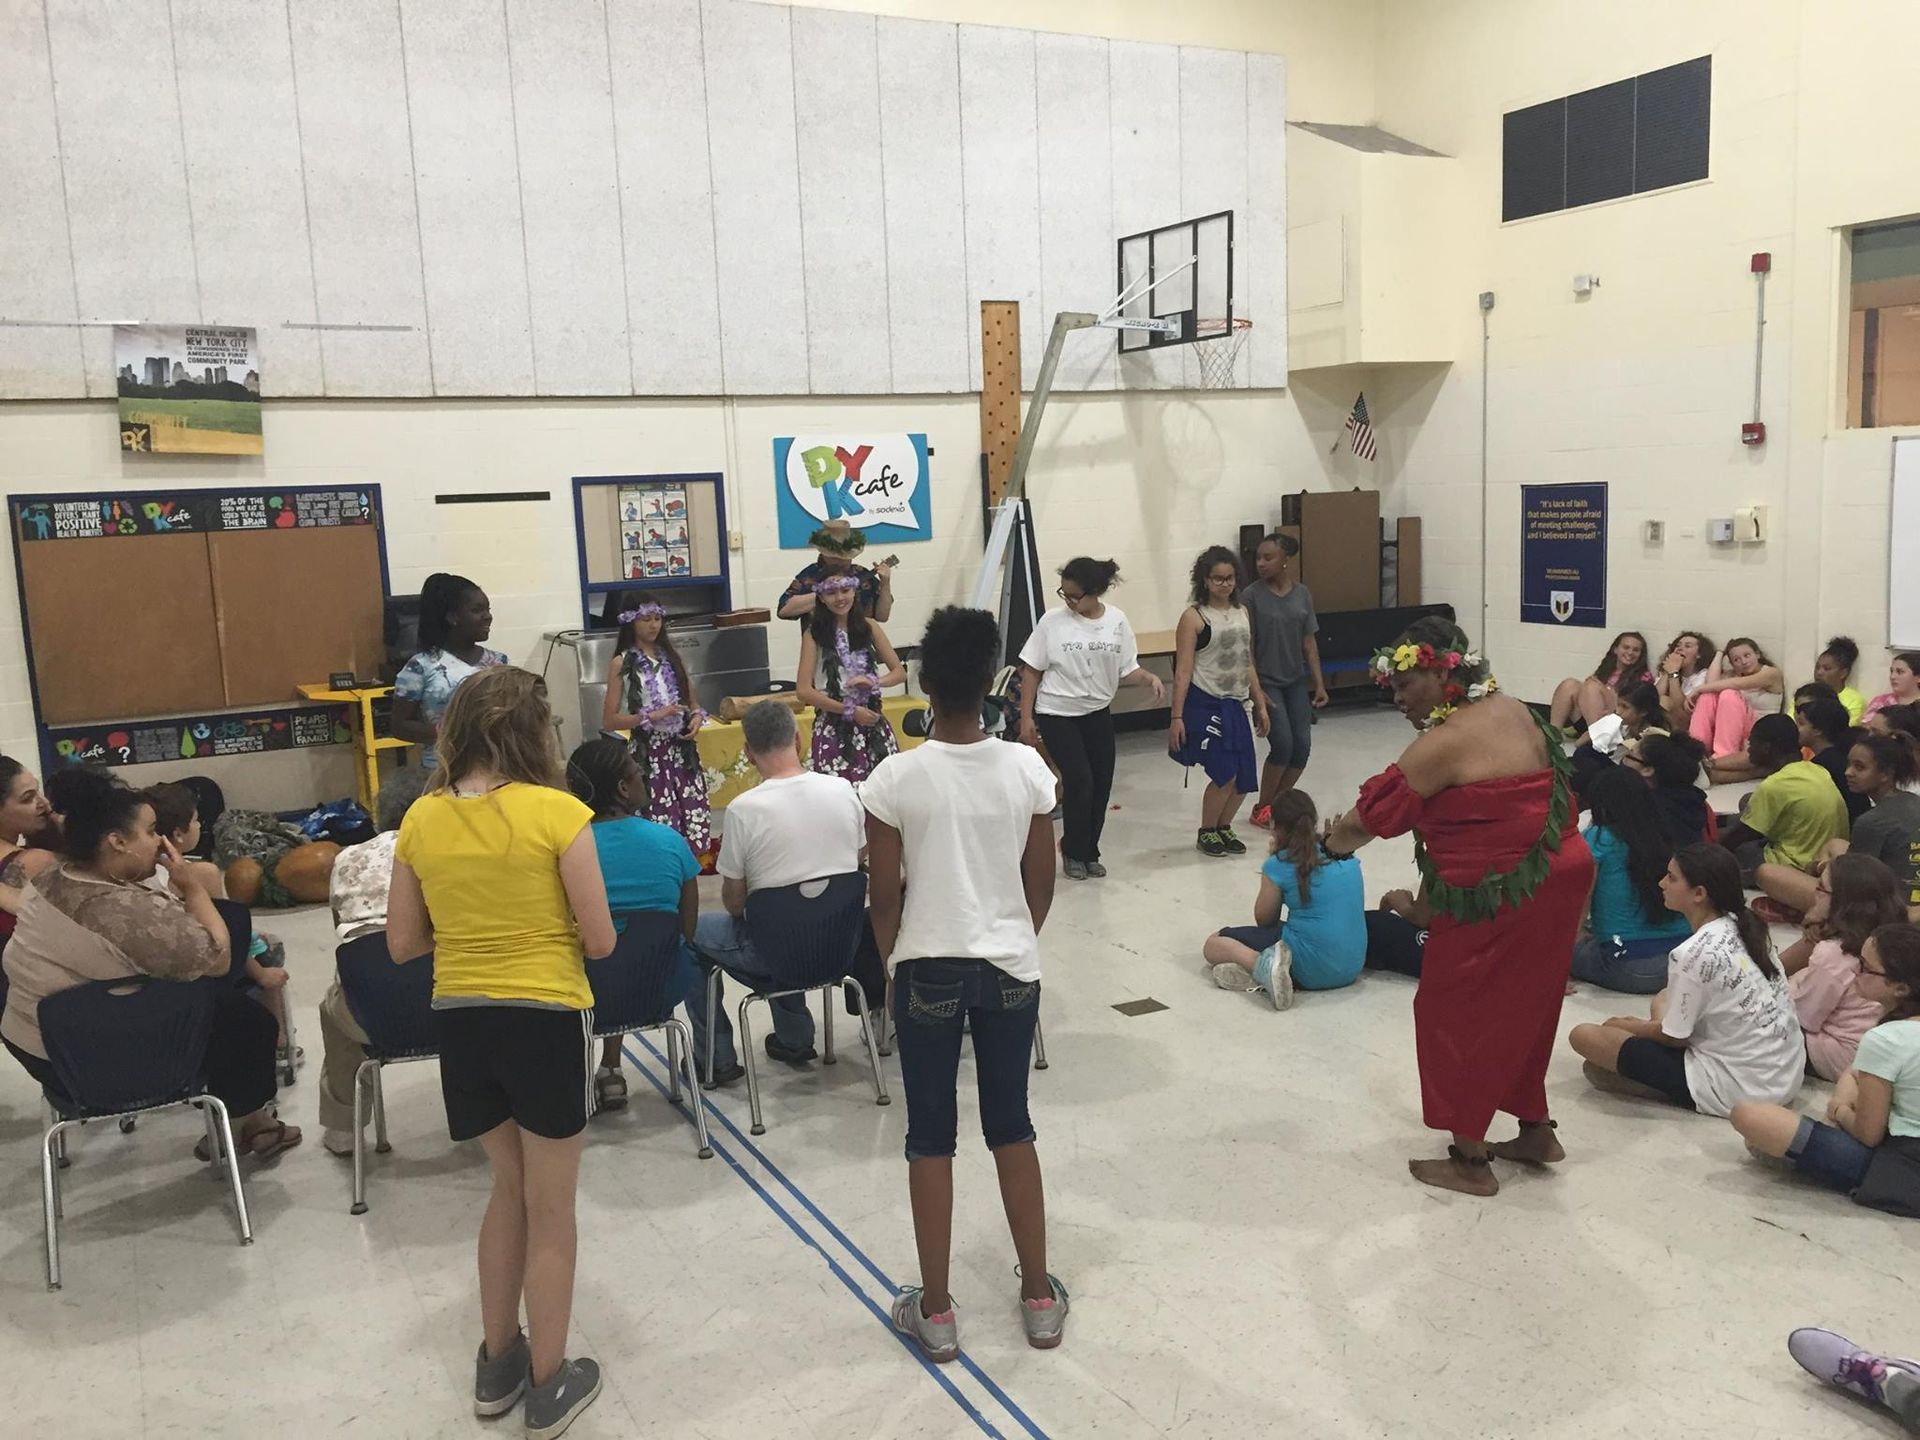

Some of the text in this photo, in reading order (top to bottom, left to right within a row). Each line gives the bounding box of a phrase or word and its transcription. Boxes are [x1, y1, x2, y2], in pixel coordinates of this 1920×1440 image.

[186, 337, 248, 348] NEW YORK CITY
[855, 464, 904, 497] cafe
[53, 501, 100, 512] VOLUNTEERING
[220, 496, 264, 506] 20% OF THE
[1552, 500, 1565, 508] lack
[1573, 500, 1588, 508] faith
[54, 511, 100, 520] OFFERS MANY
[167, 508, 192, 522] cafe
[1527, 511, 1602, 520] that makes people afraid
[55, 518, 102, 530] POSITIVE
[223, 517, 267, 527] THE BRAIN
[1530, 521, 1537, 529] of
[1537, 521, 1562, 530] meeting
[1527, 532, 1539, 540] and
[295, 714, 329, 726] PEARS
[296, 732, 329, 744] FAMILY
[80, 744, 105, 758] cafe
